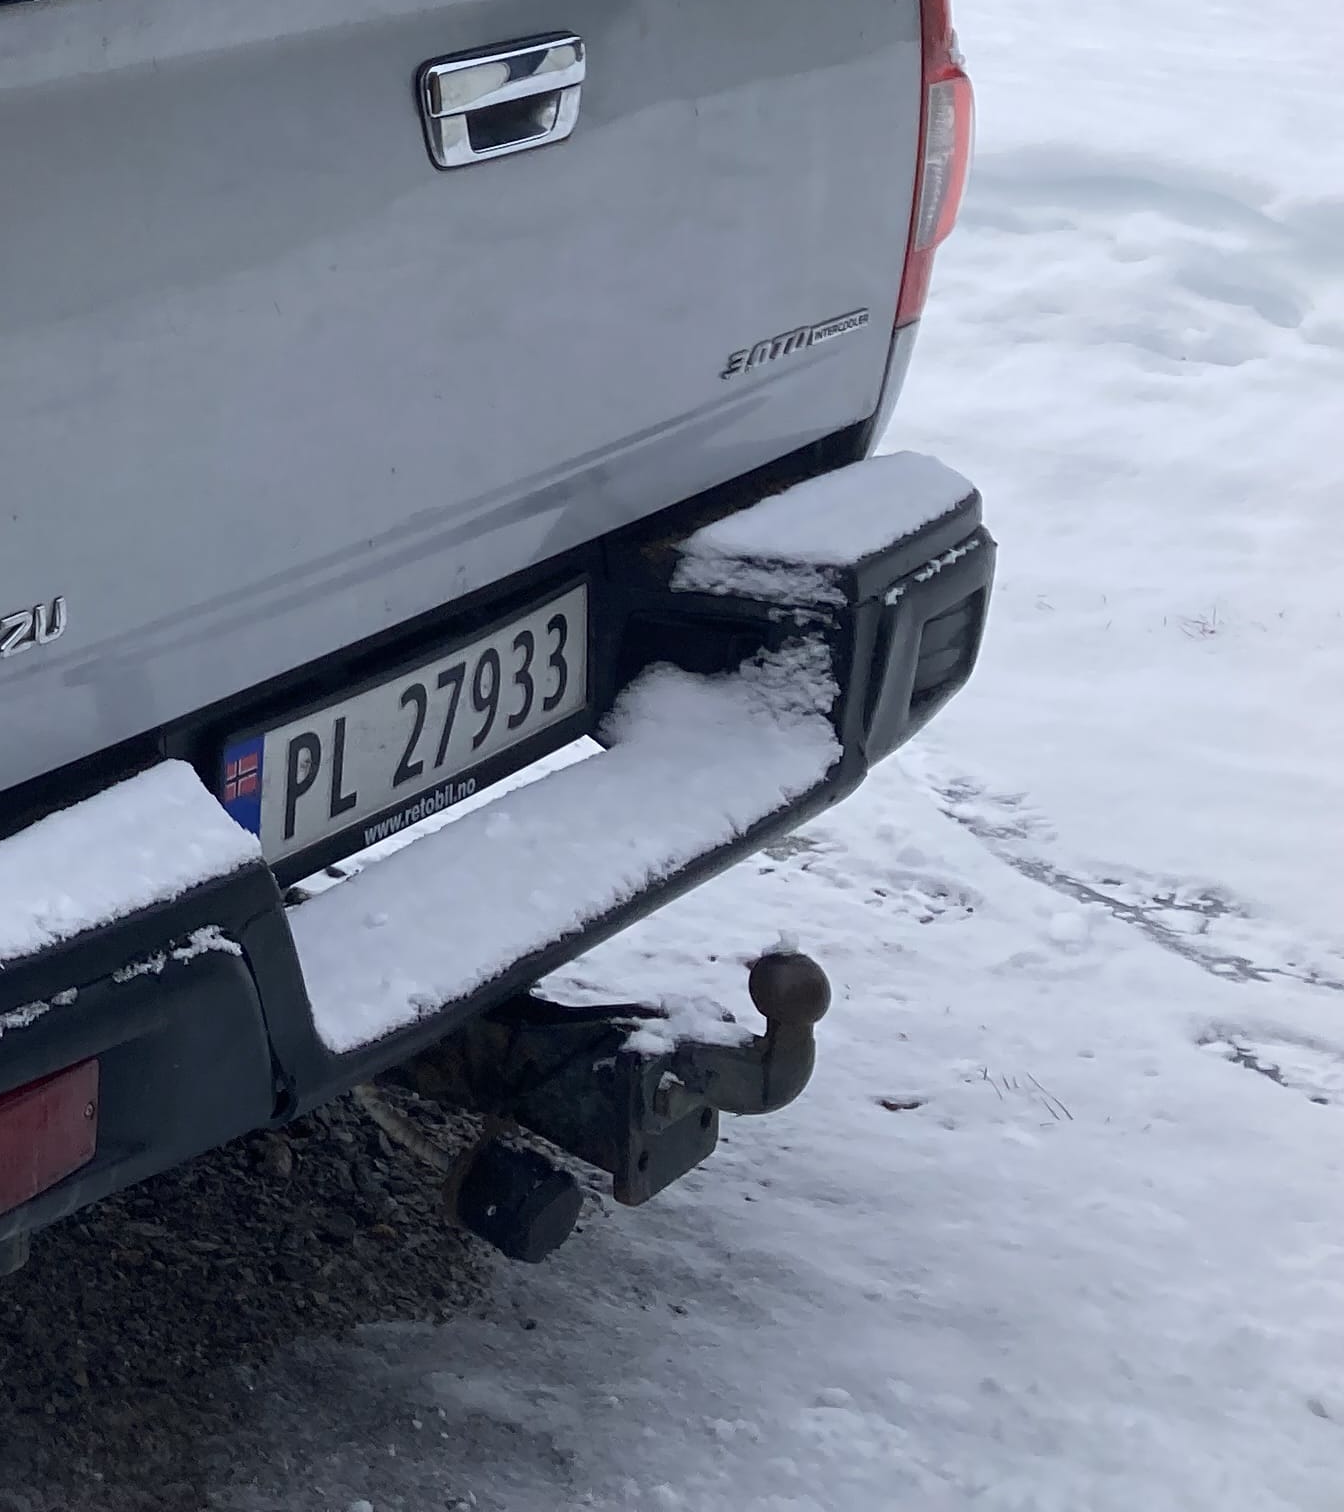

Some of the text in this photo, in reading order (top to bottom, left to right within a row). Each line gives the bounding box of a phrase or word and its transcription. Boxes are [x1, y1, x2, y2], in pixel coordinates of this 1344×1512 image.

[284, 613, 568, 840] PL 27933
[364, 778, 476, 845] www.retobil.no
